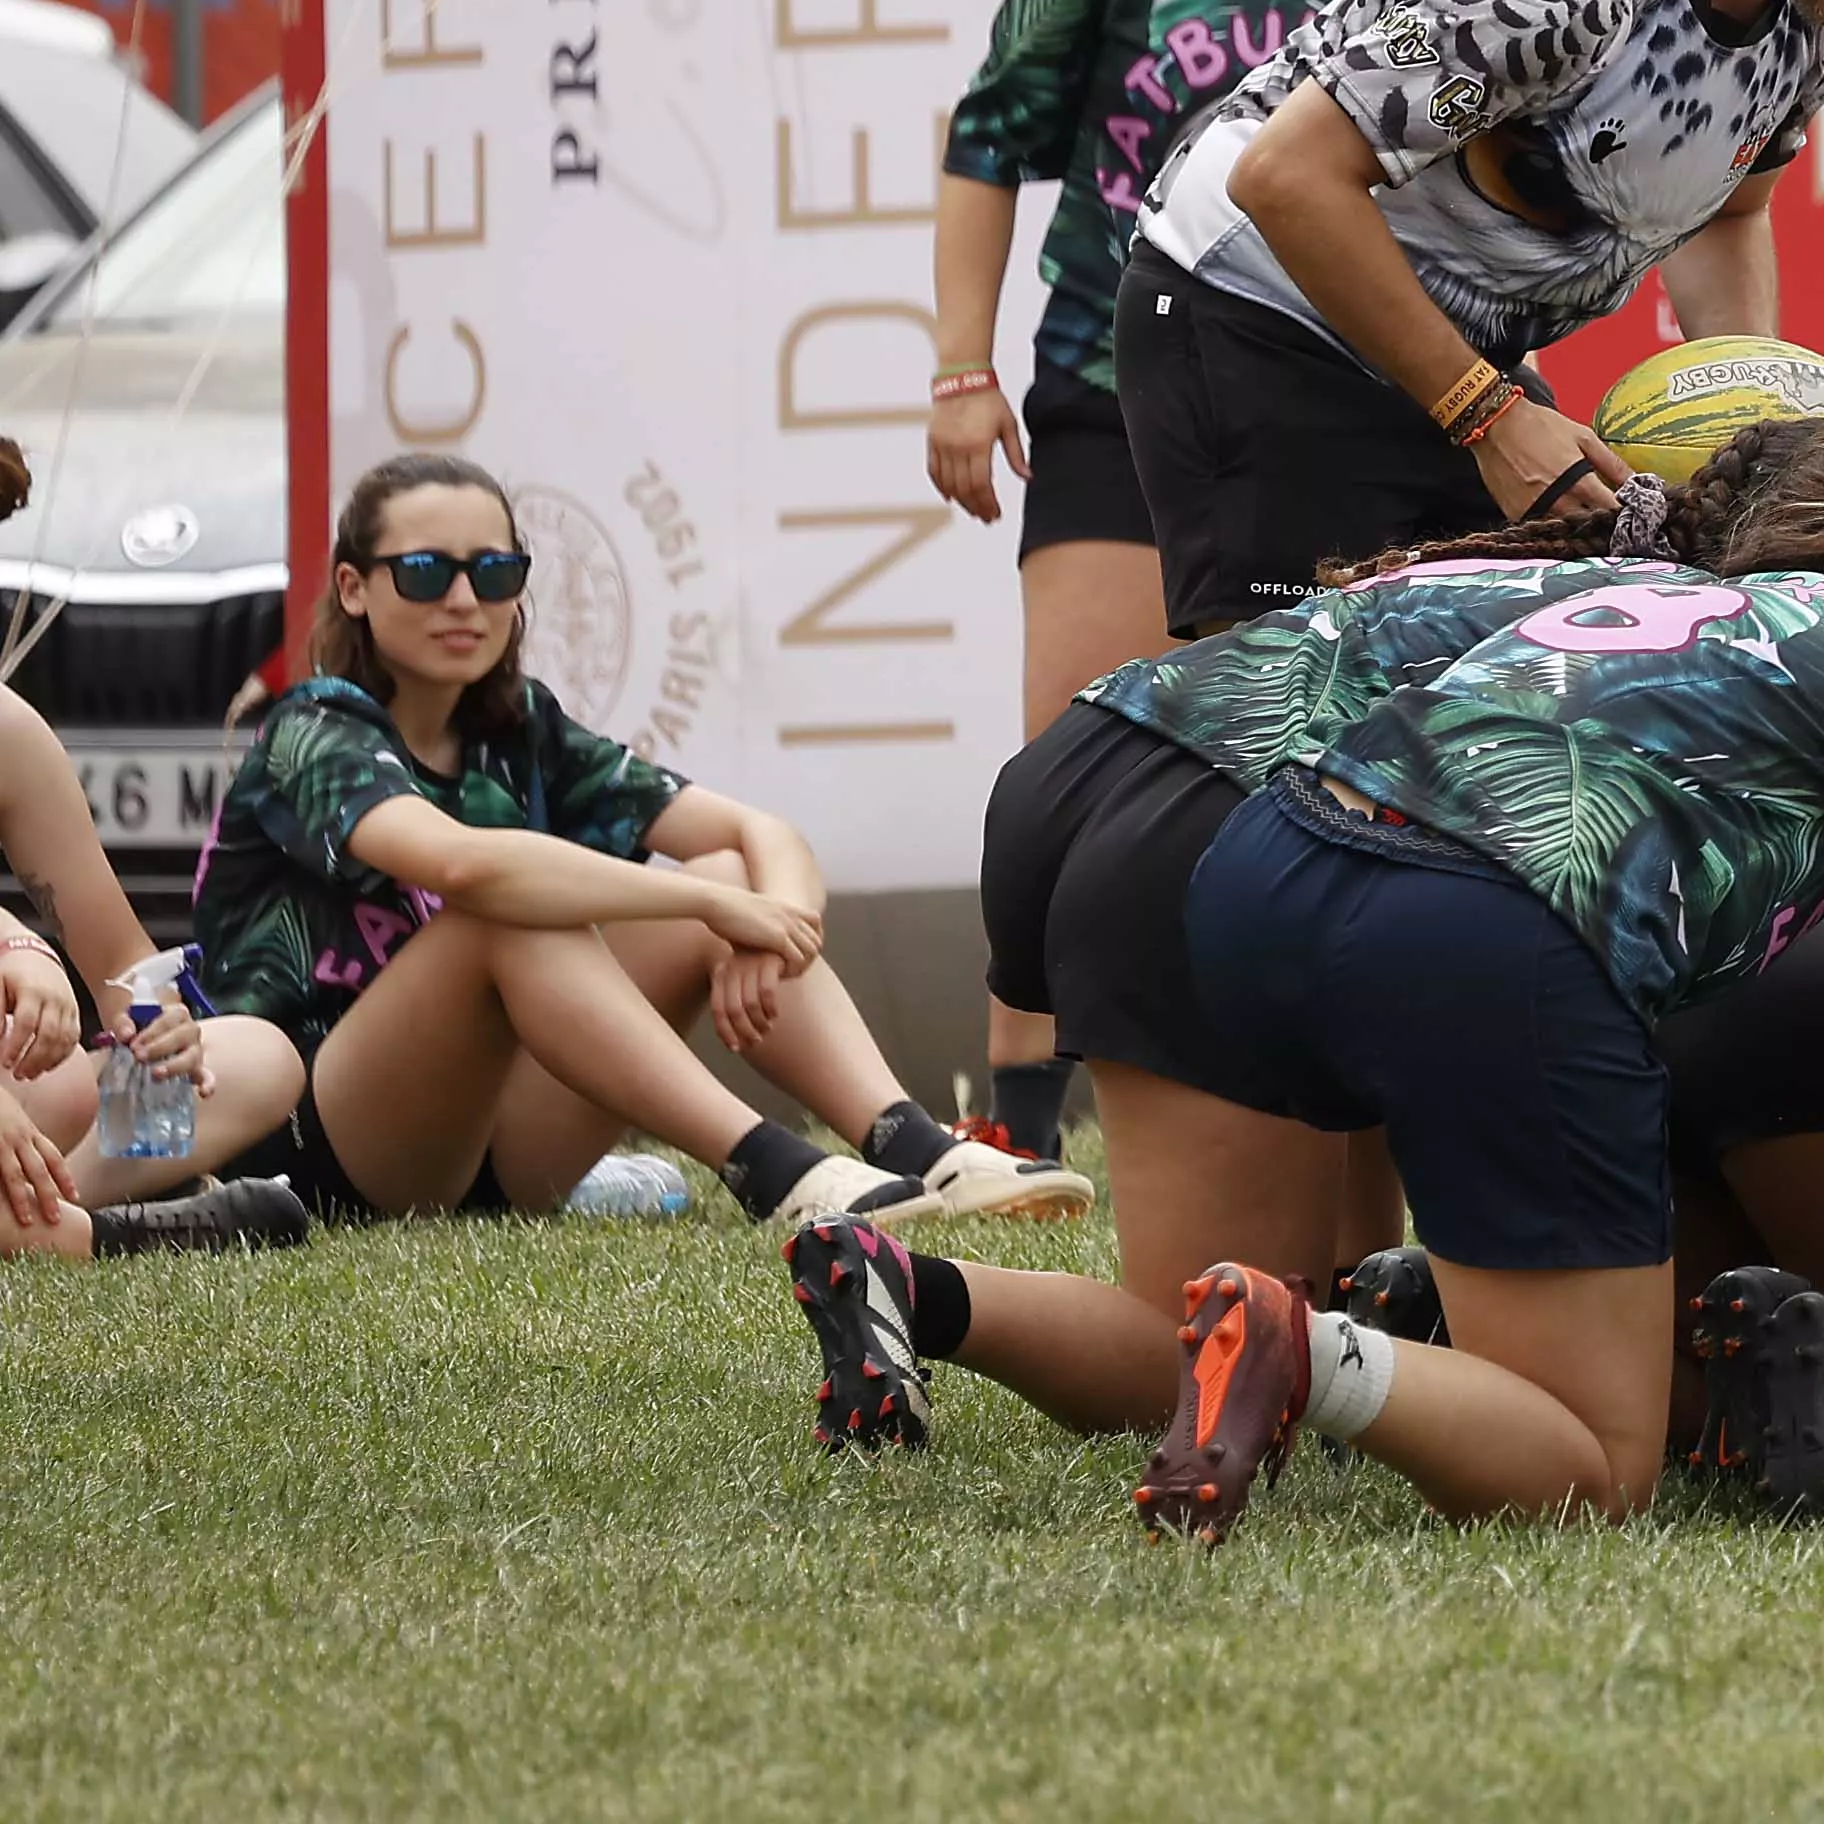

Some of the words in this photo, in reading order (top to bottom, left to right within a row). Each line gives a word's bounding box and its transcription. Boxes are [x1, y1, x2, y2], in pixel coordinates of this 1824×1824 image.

[1095, 8, 1318, 214] FATBU
[1445, 381, 1477, 412] RUGBY
[1471, 364, 1490, 383] FAT
[623, 460, 705, 593] 1902
